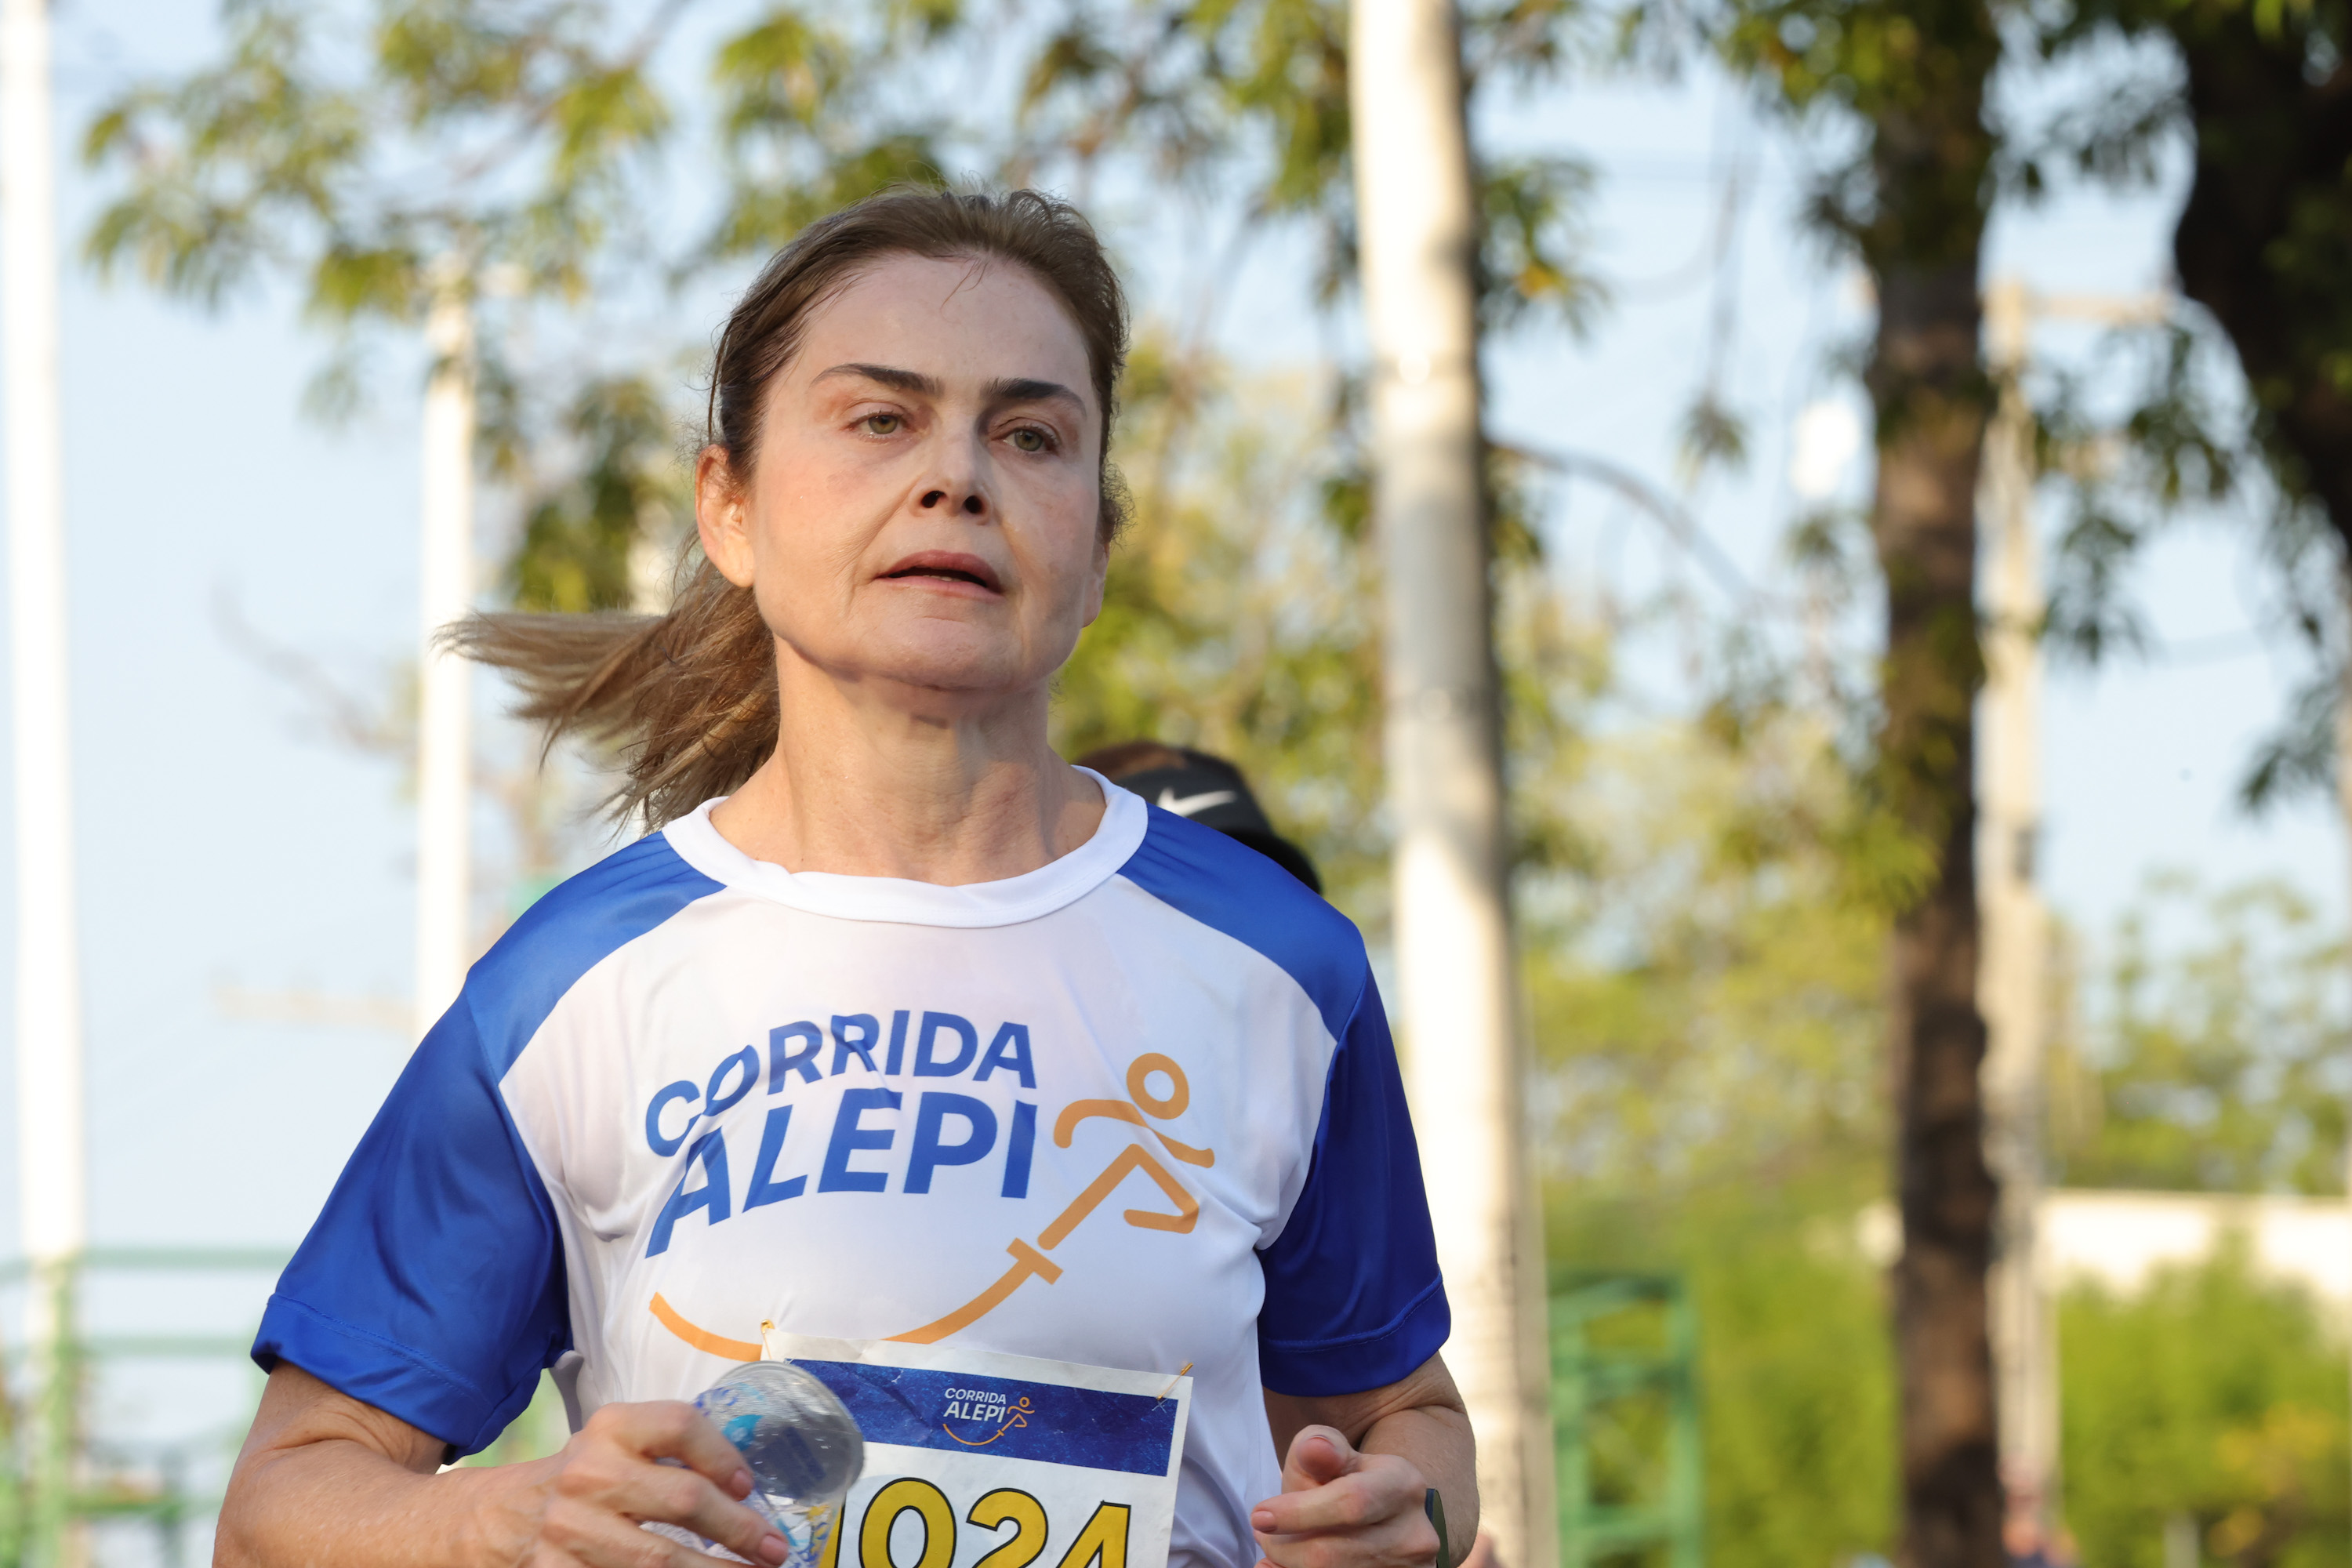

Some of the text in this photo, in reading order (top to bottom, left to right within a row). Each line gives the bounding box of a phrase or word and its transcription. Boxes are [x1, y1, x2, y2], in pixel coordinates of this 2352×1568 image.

[645, 1010, 1037, 1157] CORRIDA
[644, 1088, 1038, 1259] ALEPI
[943, 1401, 1006, 1423] ALEPI
[944, 1387, 1007, 1405] CORRIDA
[818, 1477, 1131, 1568] 024
